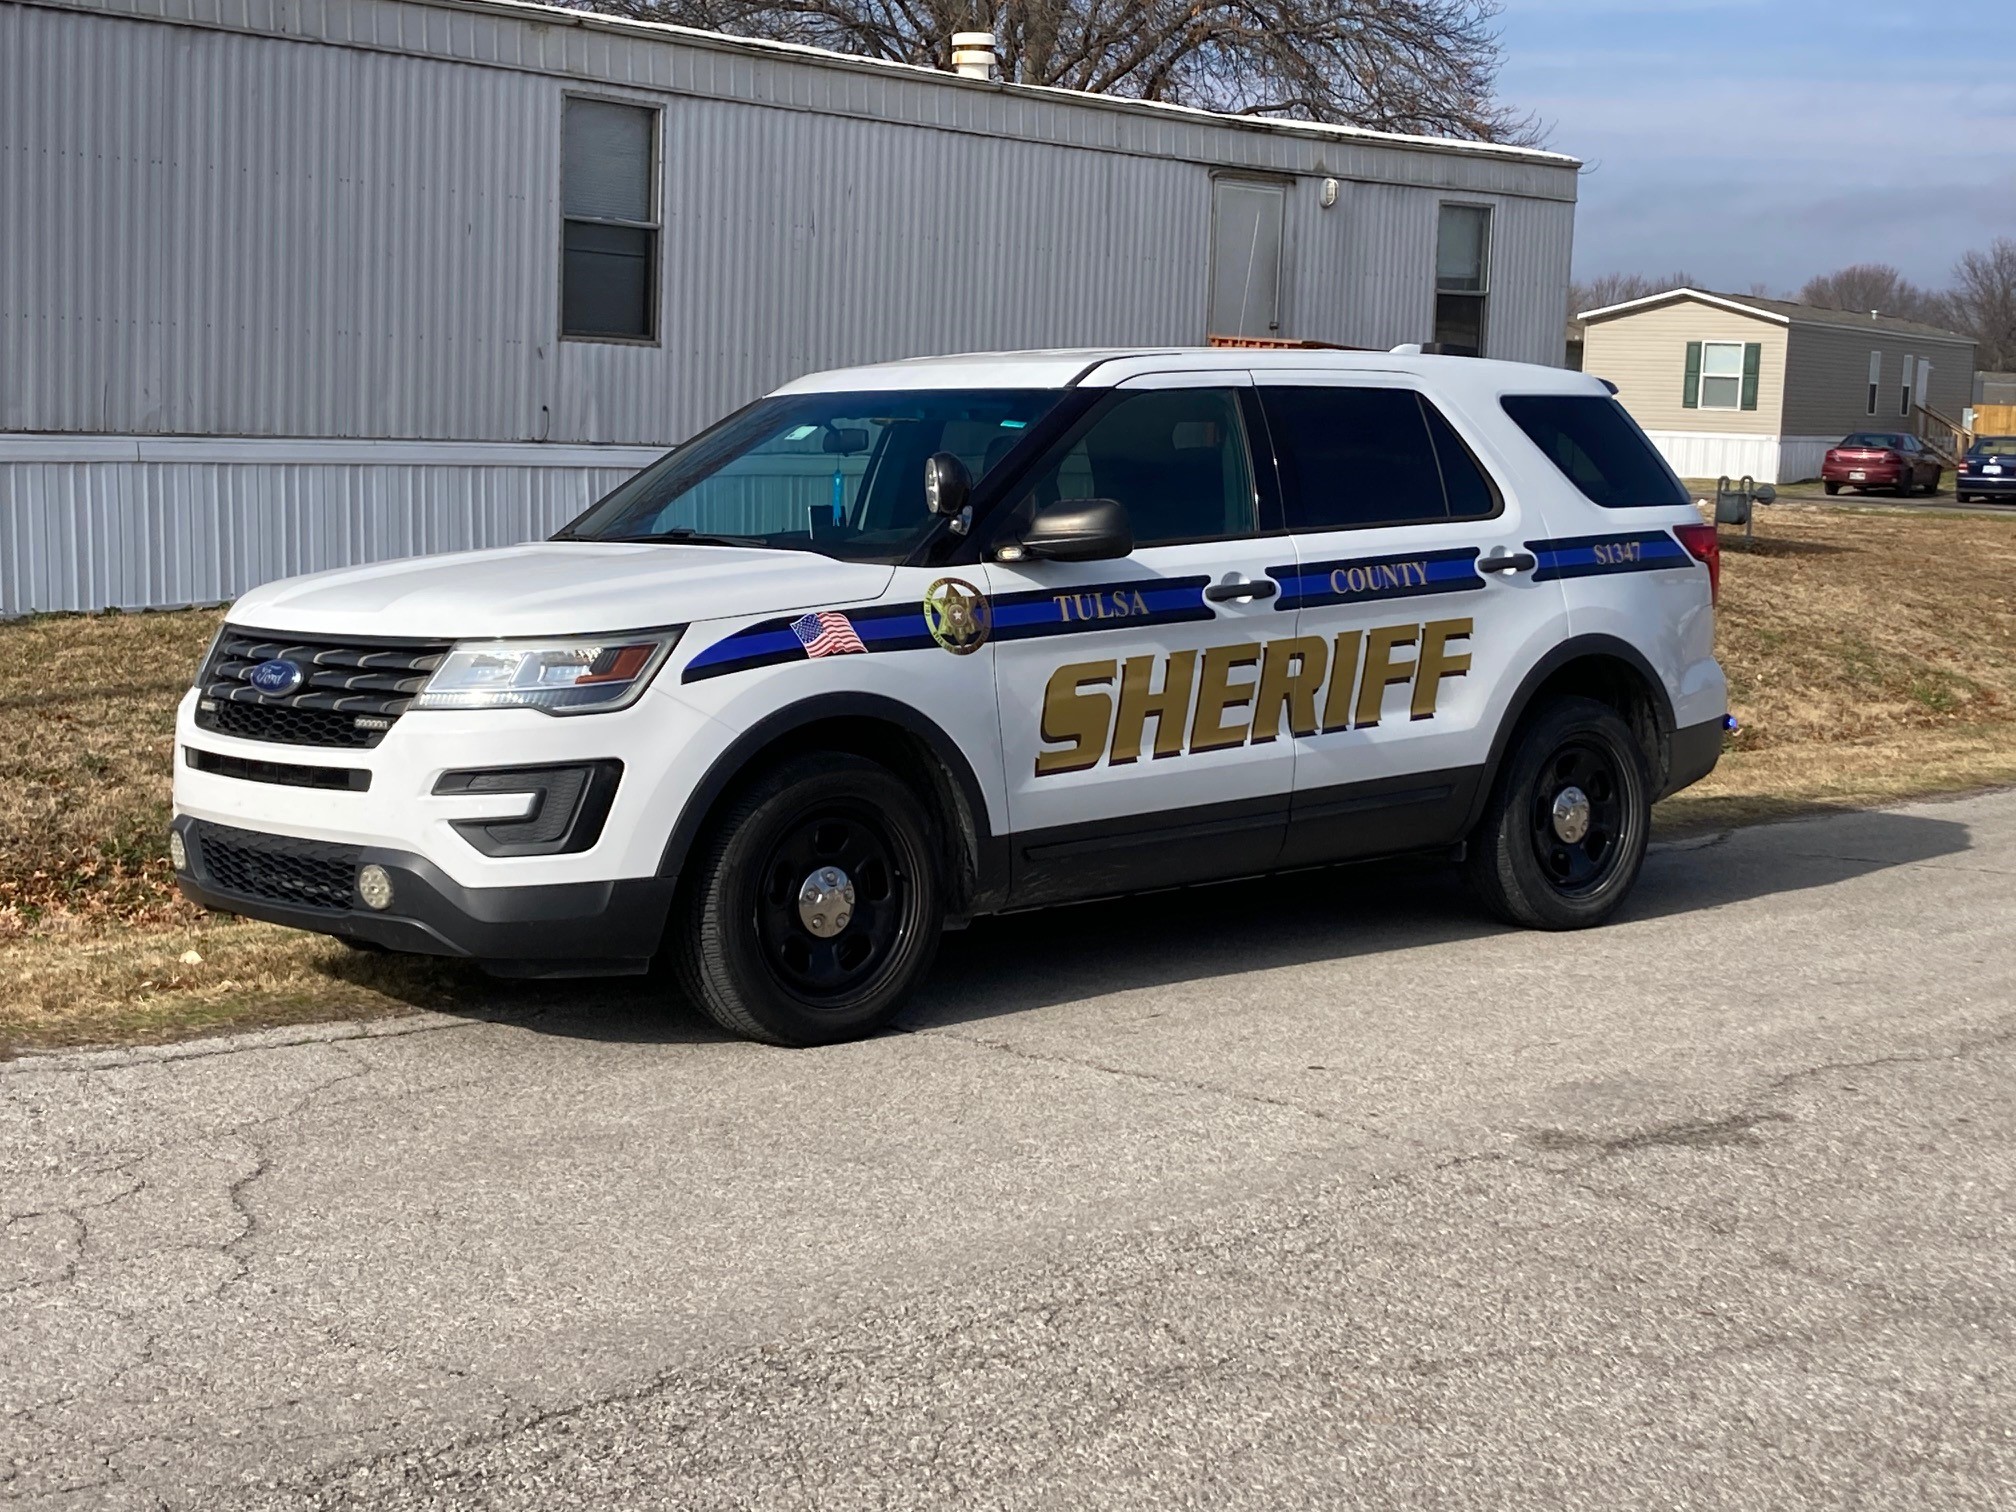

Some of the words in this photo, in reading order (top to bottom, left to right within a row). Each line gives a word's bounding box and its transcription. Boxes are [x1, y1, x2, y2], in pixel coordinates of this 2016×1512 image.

[1593, 541, 1641, 566] S1347
[1053, 590, 1150, 623] TULSA
[1330, 561, 1429, 595] COUNTY
[255, 664, 287, 686] Ford
[1035, 617, 1474, 778] SHERIFF
